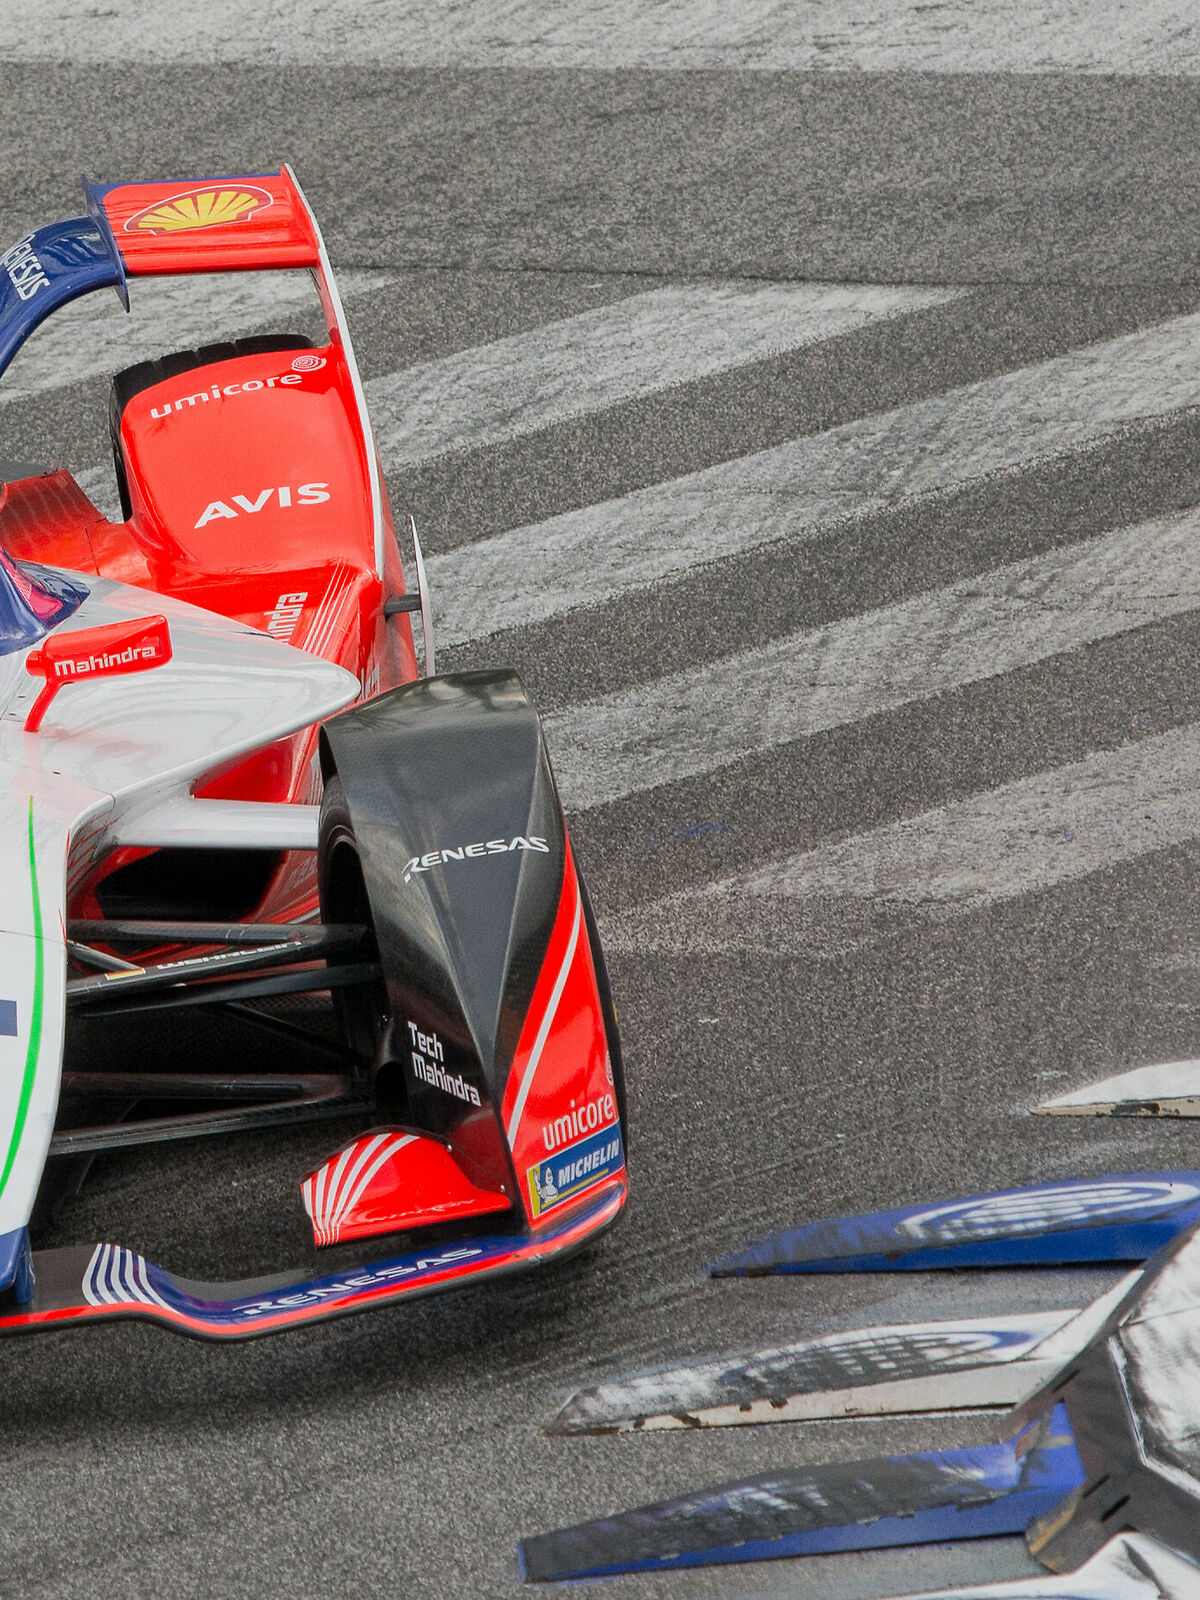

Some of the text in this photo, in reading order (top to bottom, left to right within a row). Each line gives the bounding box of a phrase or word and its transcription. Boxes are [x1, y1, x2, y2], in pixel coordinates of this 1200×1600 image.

[150, 372, 302, 419] umicore
[193, 482, 331, 528] AVIS
[54, 646, 156, 676] Mahindra
[401, 836, 550, 883] RENESAS
[408, 1021, 444, 1062] Tech
[412, 1052, 482, 1107] Mahindra
[542, 1094, 614, 1150] umicore
[558, 1138, 620, 1187] MICHELIN
[232, 1248, 482, 1315] RENESAS
